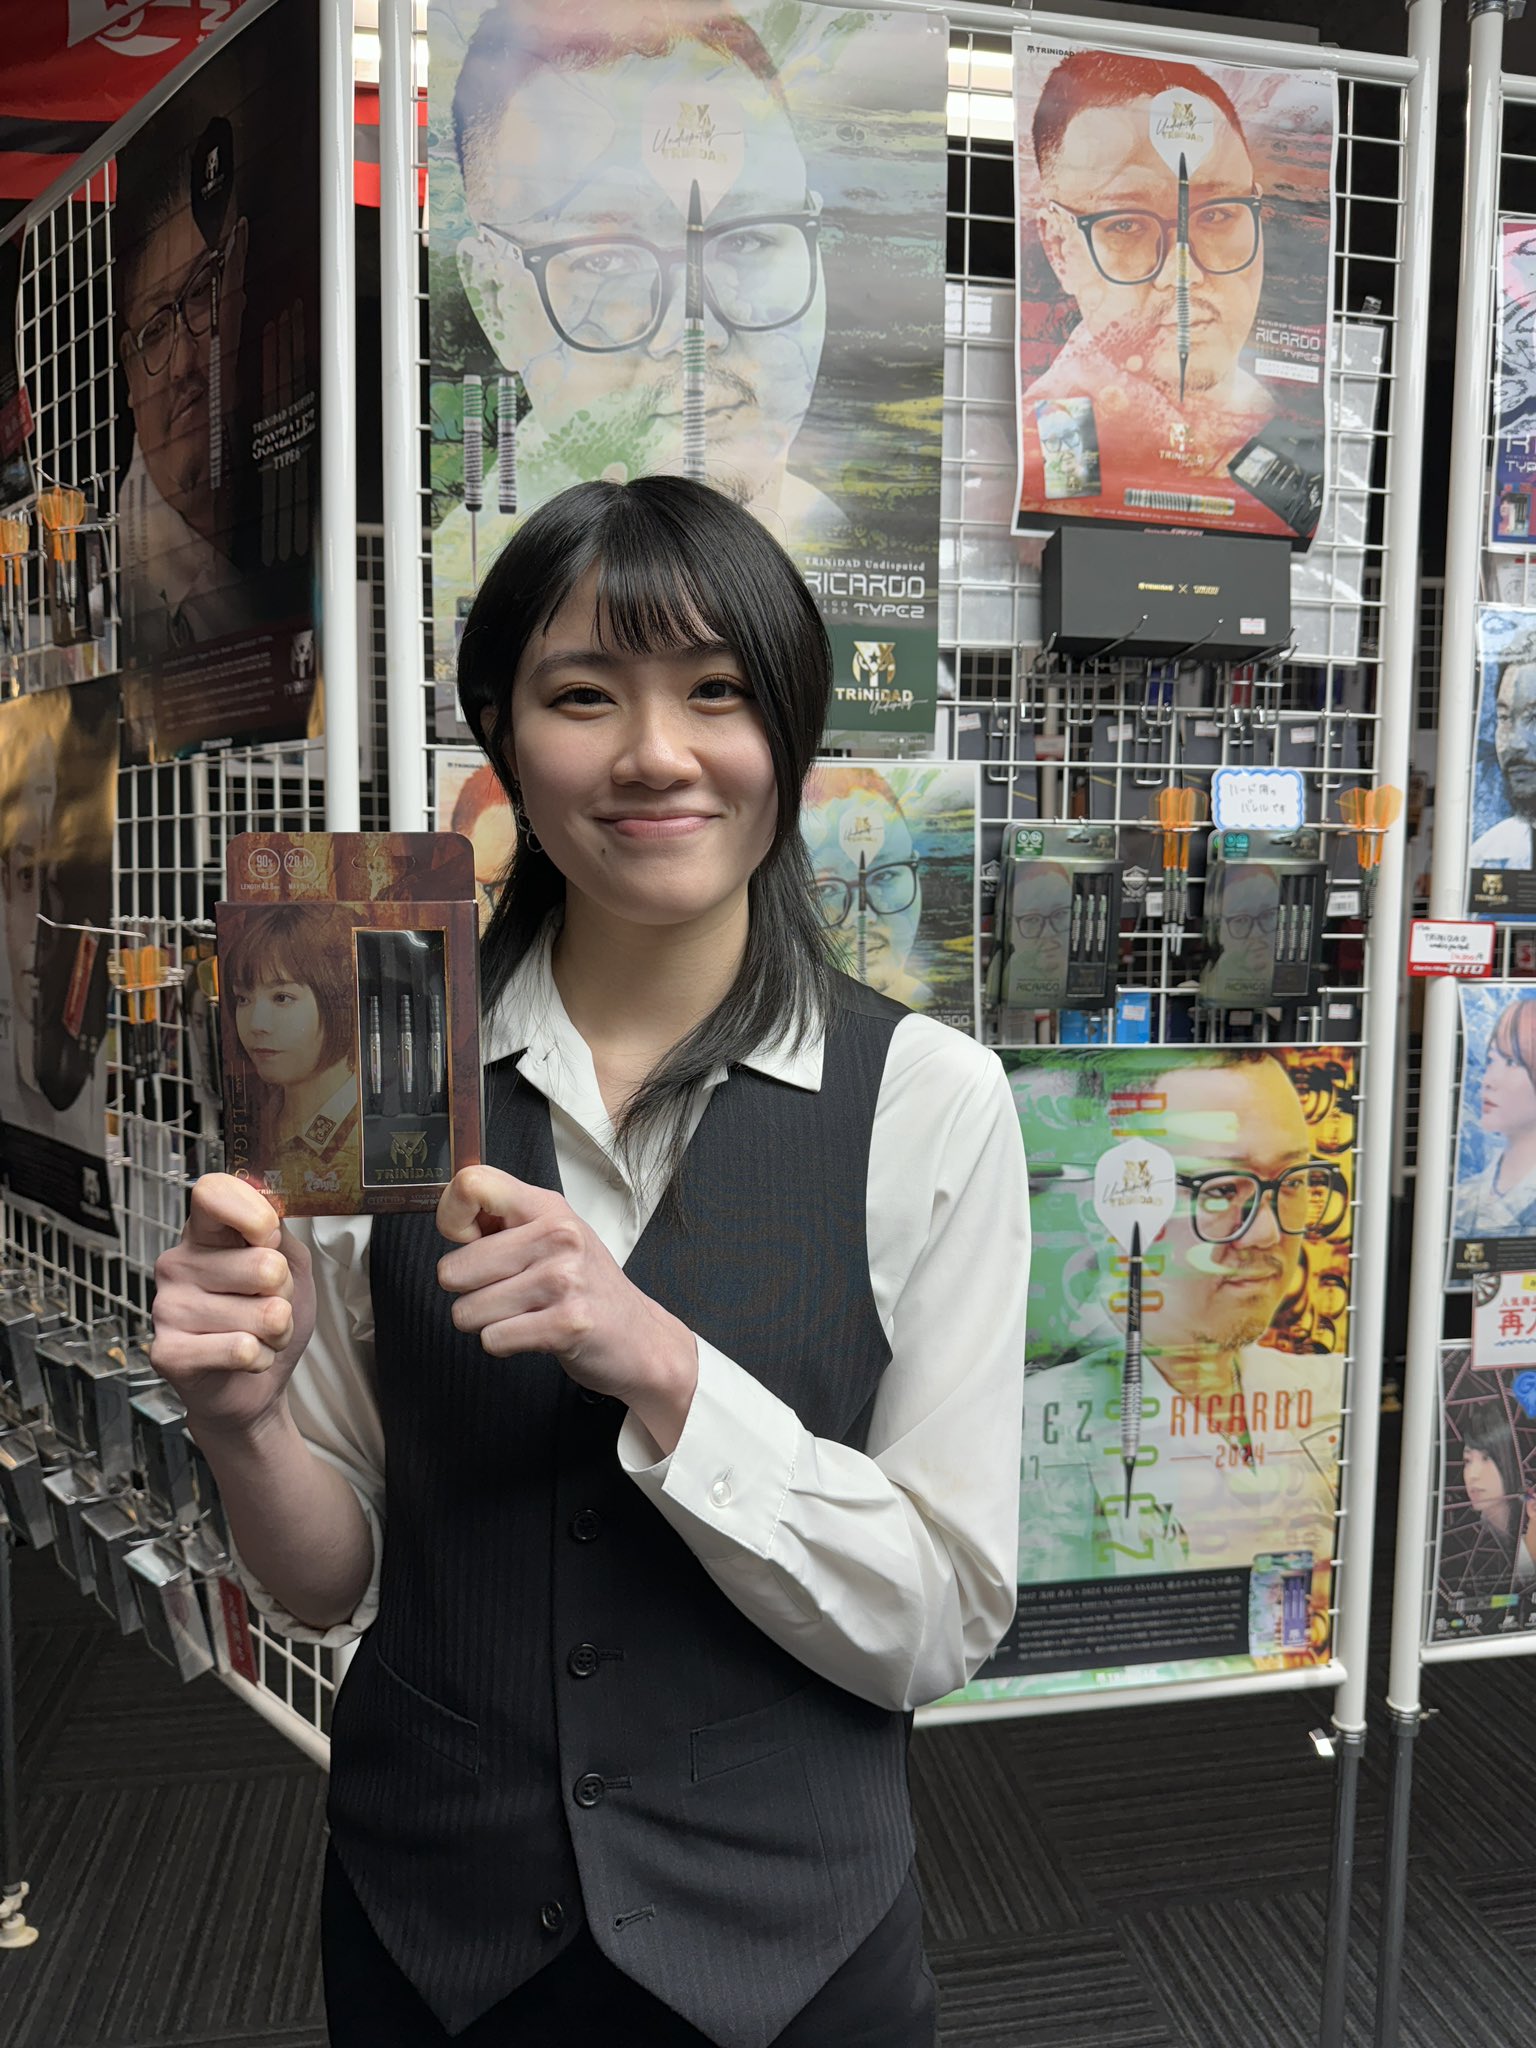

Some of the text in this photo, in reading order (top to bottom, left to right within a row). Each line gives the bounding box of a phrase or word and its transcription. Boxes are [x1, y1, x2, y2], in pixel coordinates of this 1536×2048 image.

[1255, 327, 1321, 350] RICARDO
[865, 559, 926, 572] Undisputed
[804, 570, 926, 599] RICARDO
[854, 602, 925, 619] TYPE2
[1170, 1389, 1314, 1438] RICARDO
